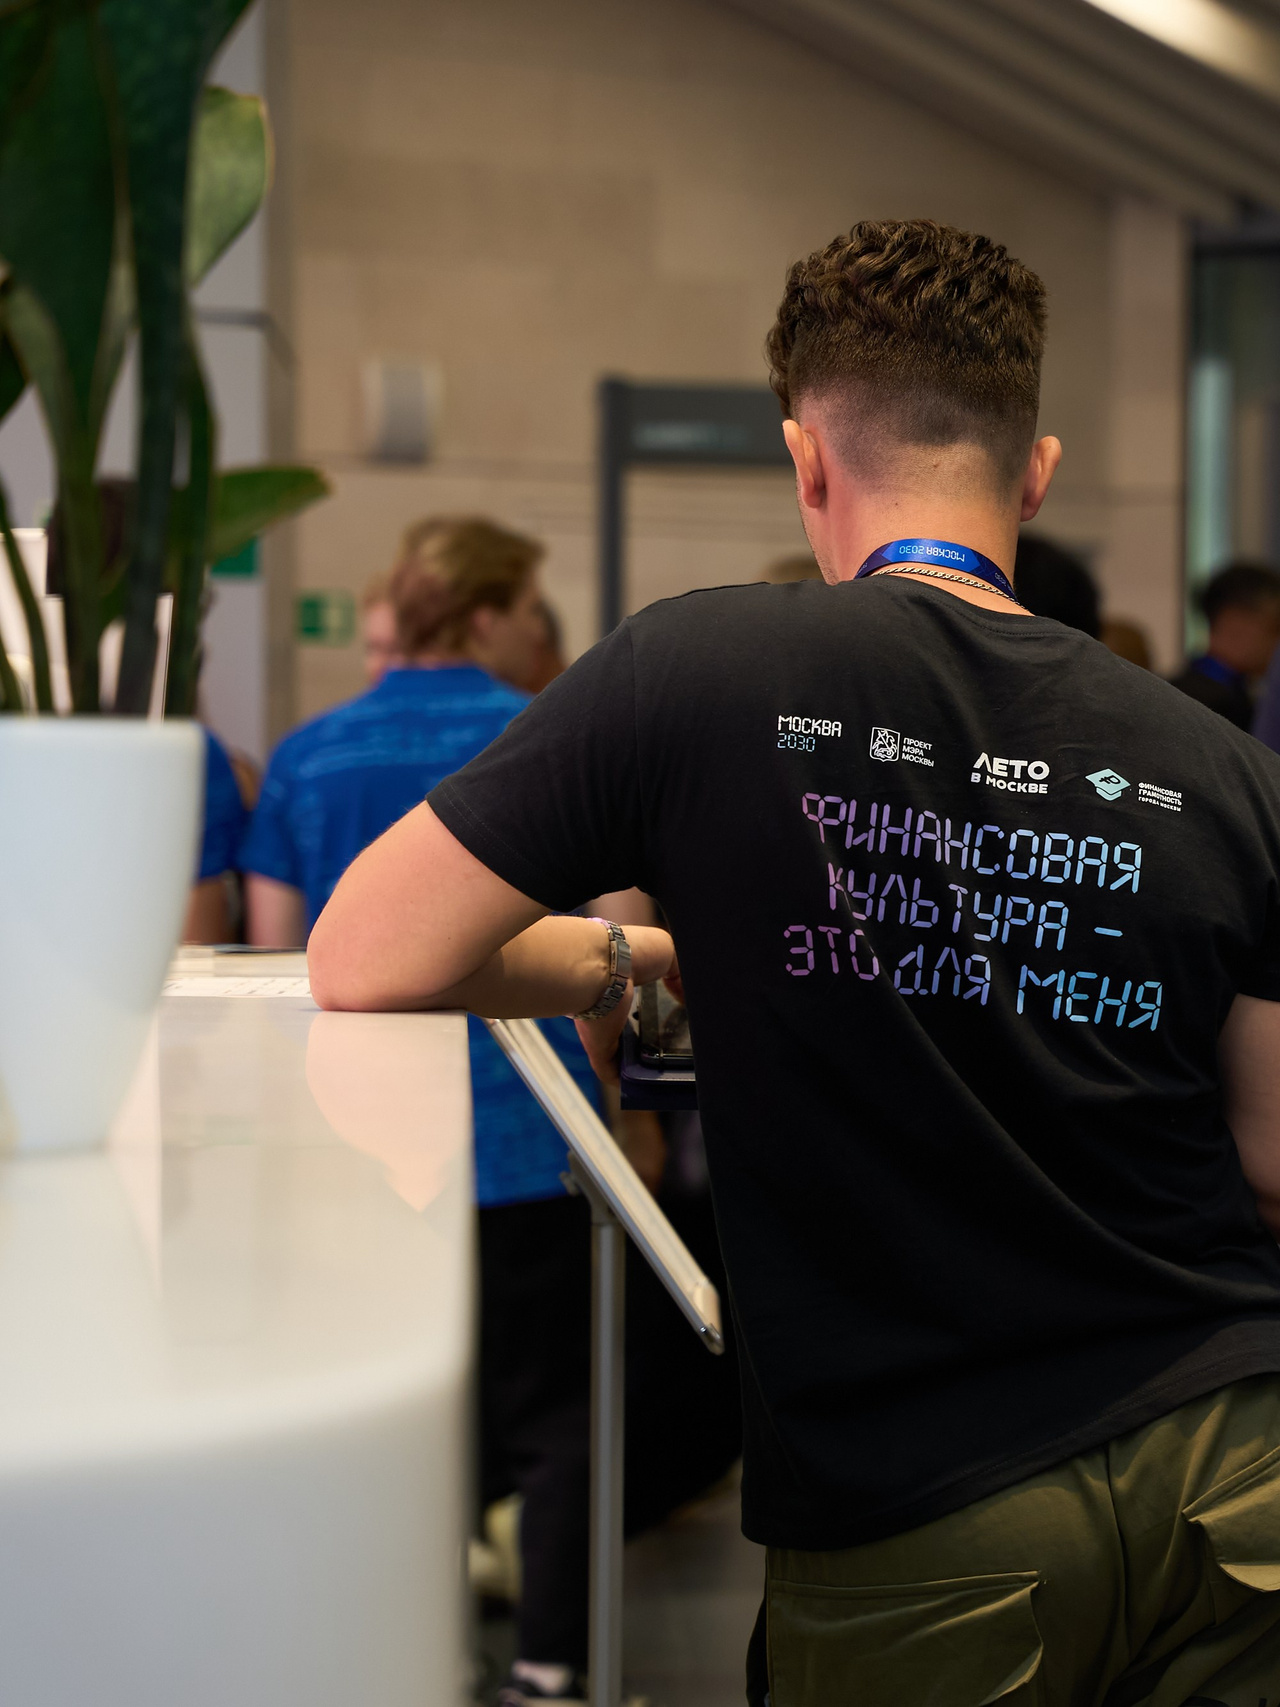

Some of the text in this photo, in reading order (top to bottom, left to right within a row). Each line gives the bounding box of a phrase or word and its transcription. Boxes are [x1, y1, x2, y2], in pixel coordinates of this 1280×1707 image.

[899, 545, 965, 562] МОСКВА 2030
[777, 715, 842, 737] МОСКВА
[777, 733, 816, 752] 2030
[902, 746, 924, 757] МЭРА
[903, 737, 933, 750] ПРОЕКТ
[901, 753, 935, 767] МОСКВЫ
[973, 752, 1050, 780] ЛЕТО
[970, 772, 1049, 794] В МОСКВЕ
[1138, 782, 1182, 798] ФИНАНСОВАЯ
[1138, 789, 1183, 806] ГРАМОТНОСТЬ
[801, 792, 1142, 893] ФИНАНСОВАЯ
[827, 861, 1069, 951] КУЛЬТУРА
[783, 925, 1163, 1031] ЭТО ДЛЯ МЕНЯ
